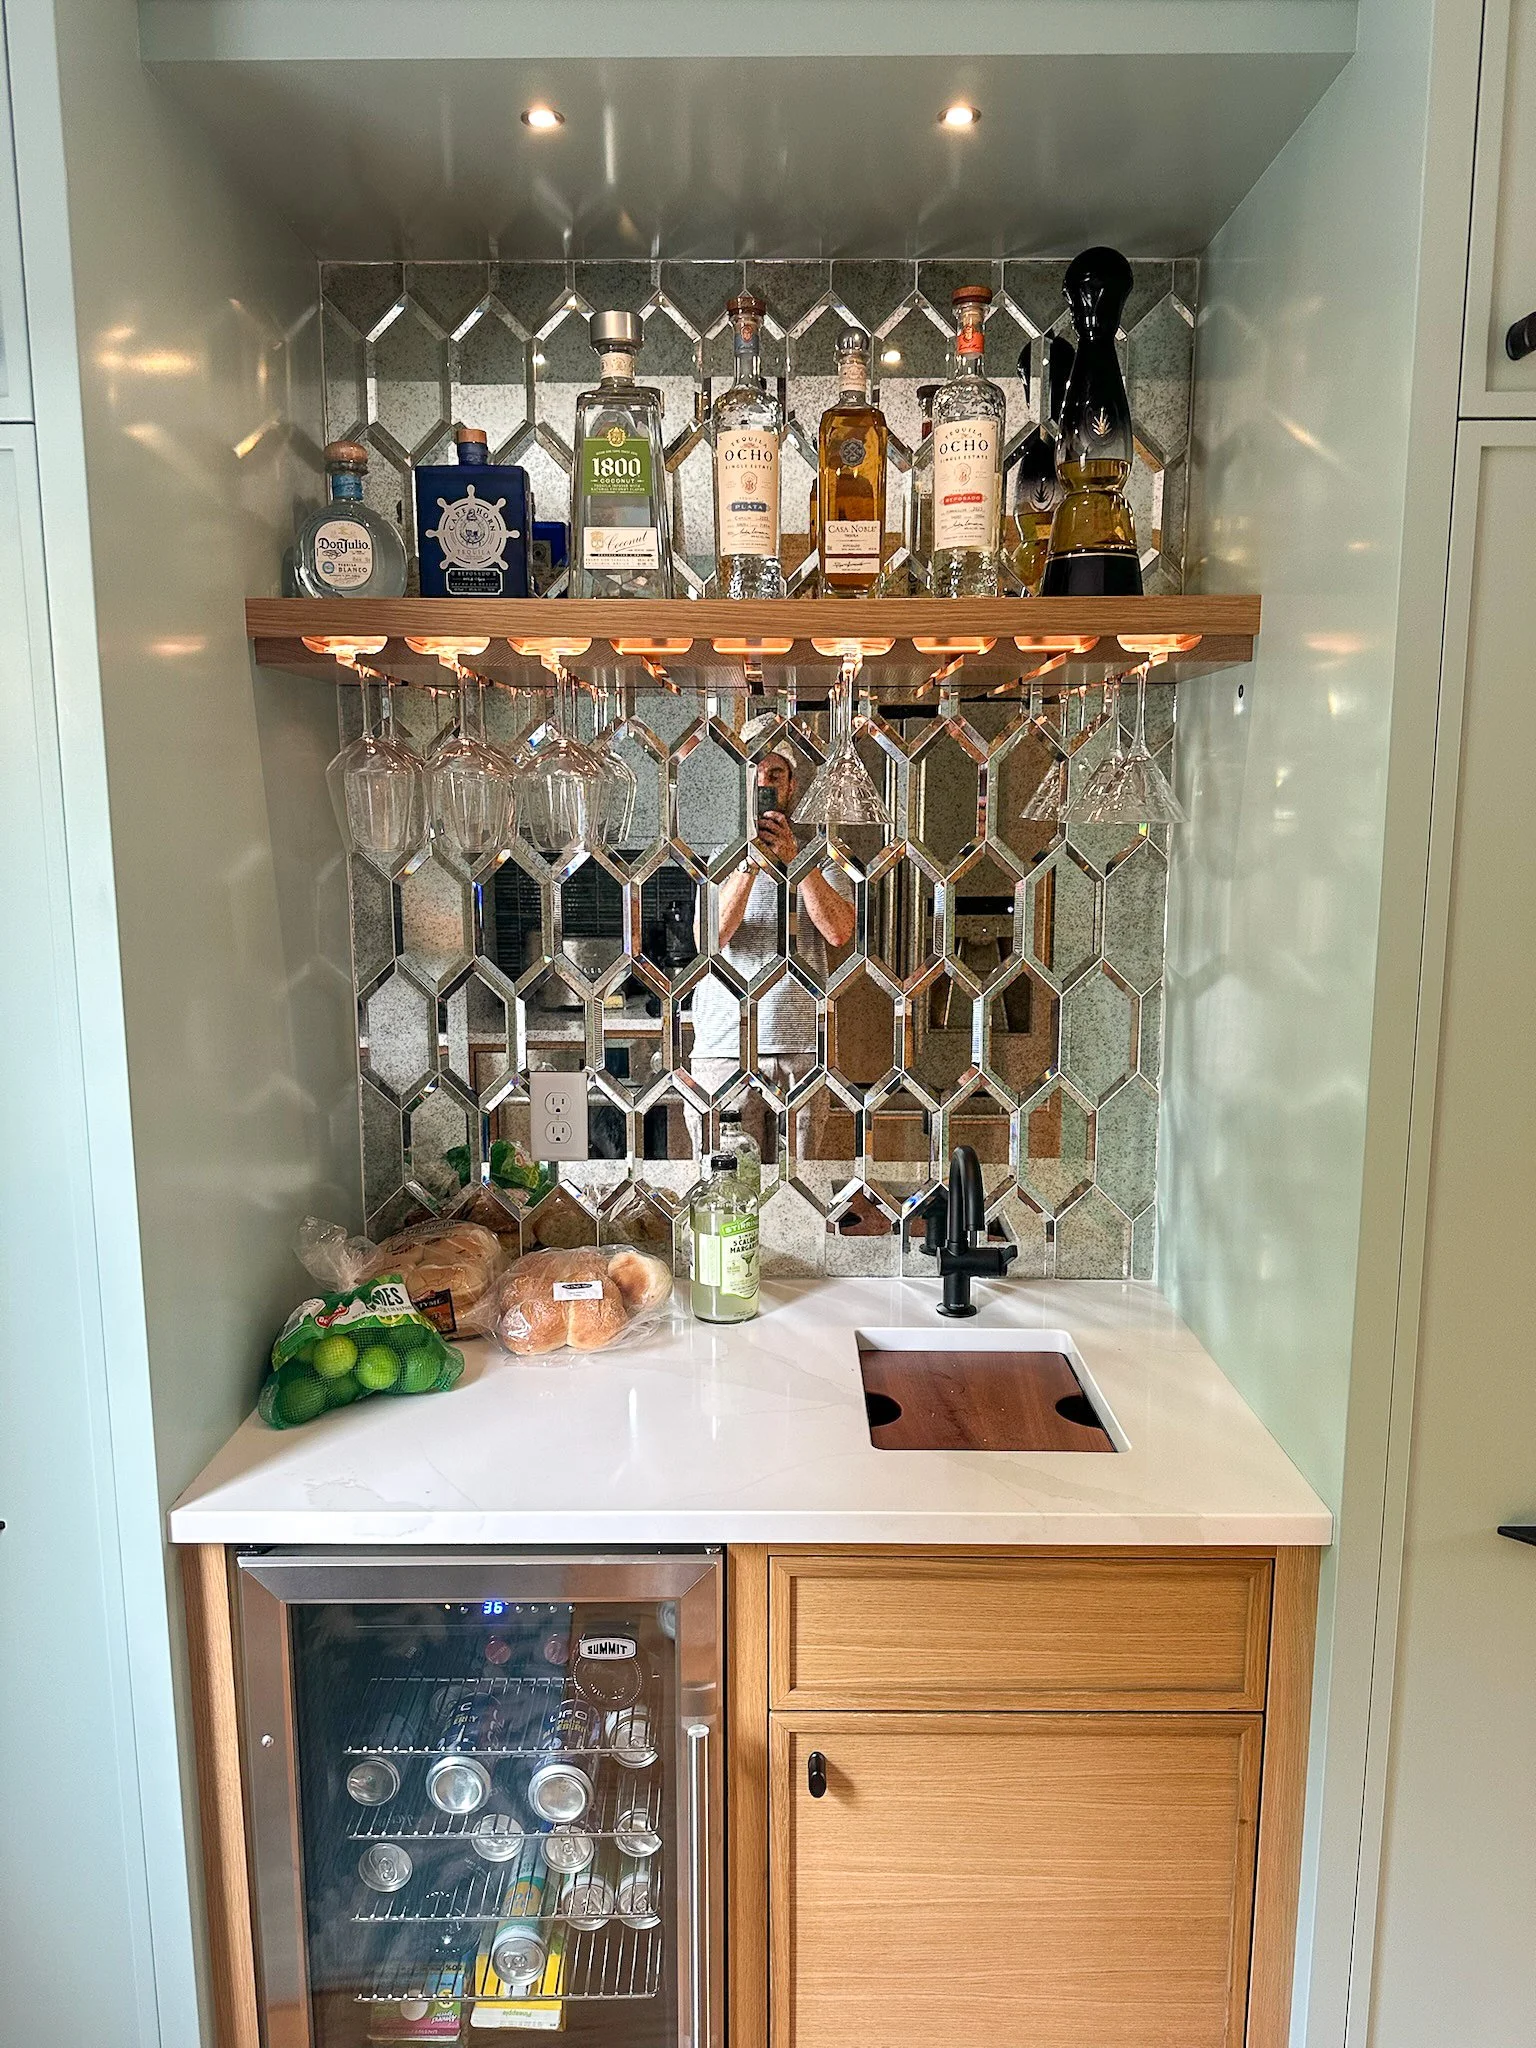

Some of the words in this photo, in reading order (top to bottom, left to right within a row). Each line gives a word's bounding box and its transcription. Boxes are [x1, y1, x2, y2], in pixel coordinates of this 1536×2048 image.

[940, 440, 988, 455] OCHO
[725, 449, 773, 462] OCHO
[591, 457, 641, 478] 1800
[448, 508, 467, 531] CAPE
[476, 508, 496, 531] HORN
[828, 524, 849, 533] CASA
[851, 524, 875, 533] NOBLE
[483, 1601, 503, 1614] 36
[587, 1641, 628, 1655] SUMMIT
[502, 2009, 532, 2017] Pineapple
